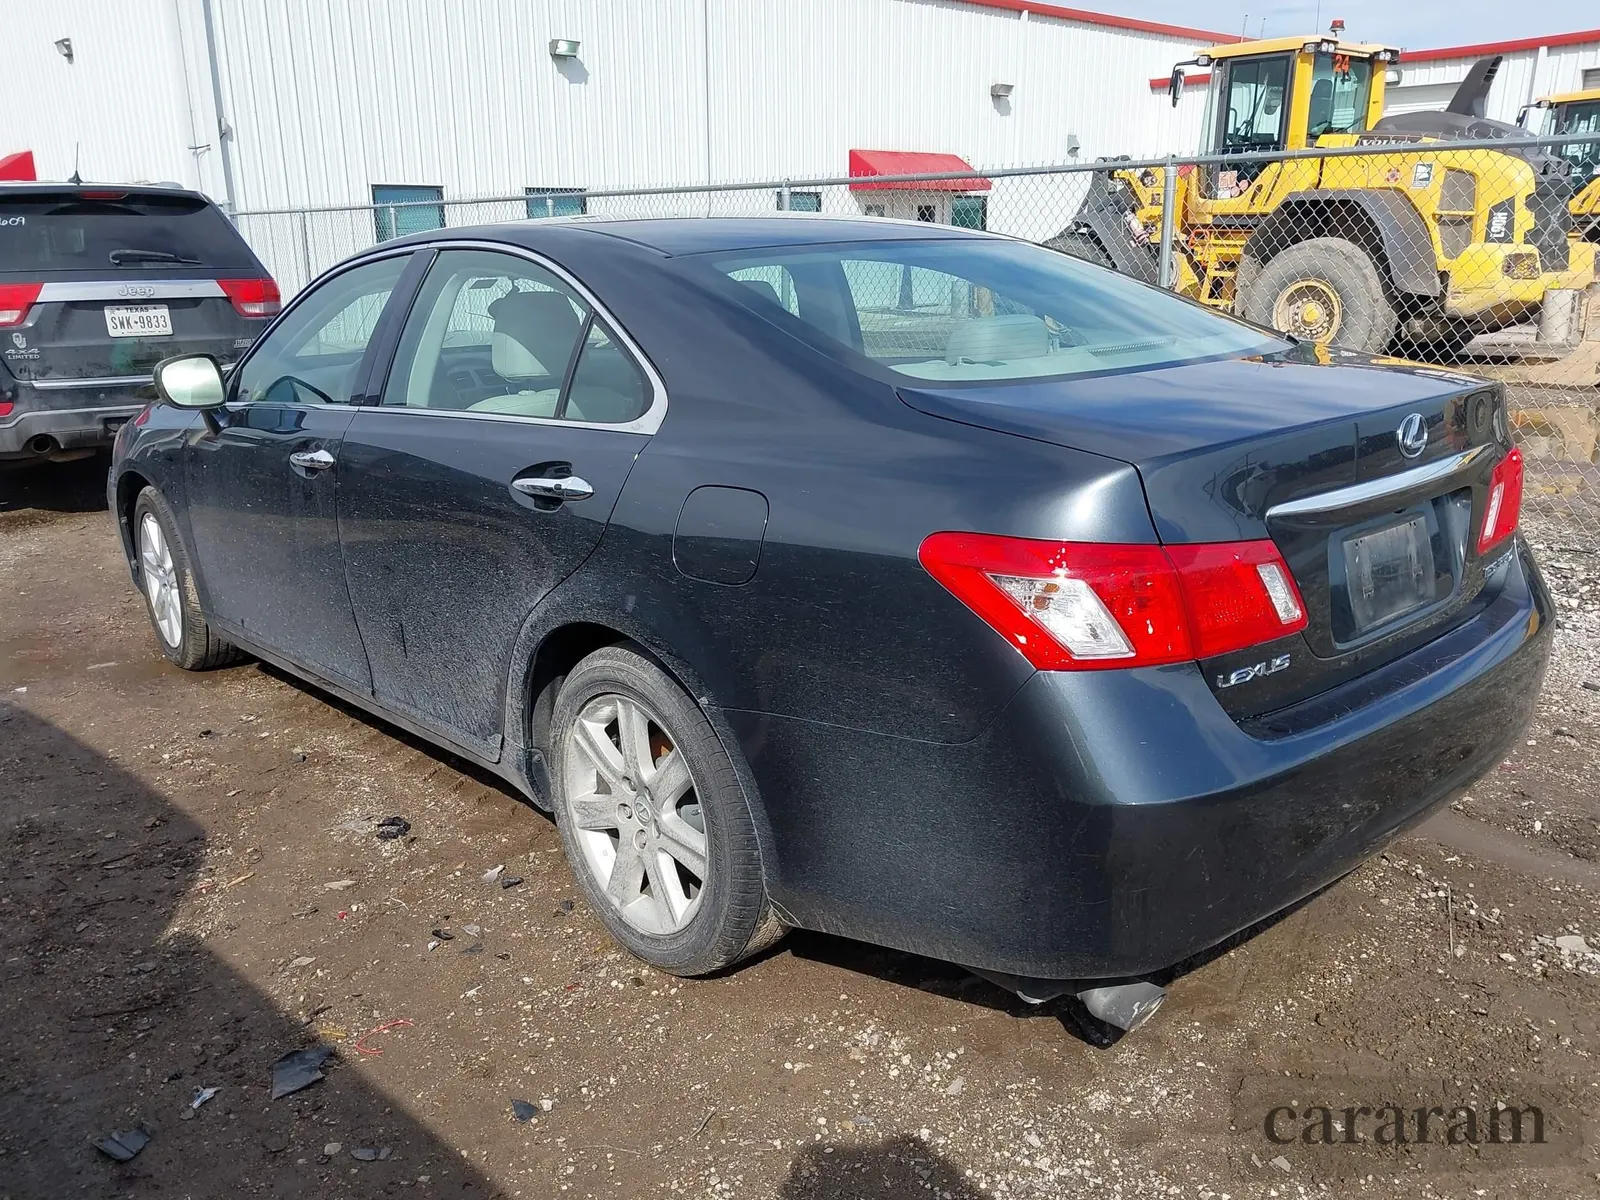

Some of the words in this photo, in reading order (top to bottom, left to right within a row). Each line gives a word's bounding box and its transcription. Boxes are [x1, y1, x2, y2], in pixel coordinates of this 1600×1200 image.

[1334, 54, 1350, 72] 24
[1490, 212, 1508, 238] L90H
[118, 284, 155, 297] Jeep
[1217, 653, 1291, 688] LEXUS
